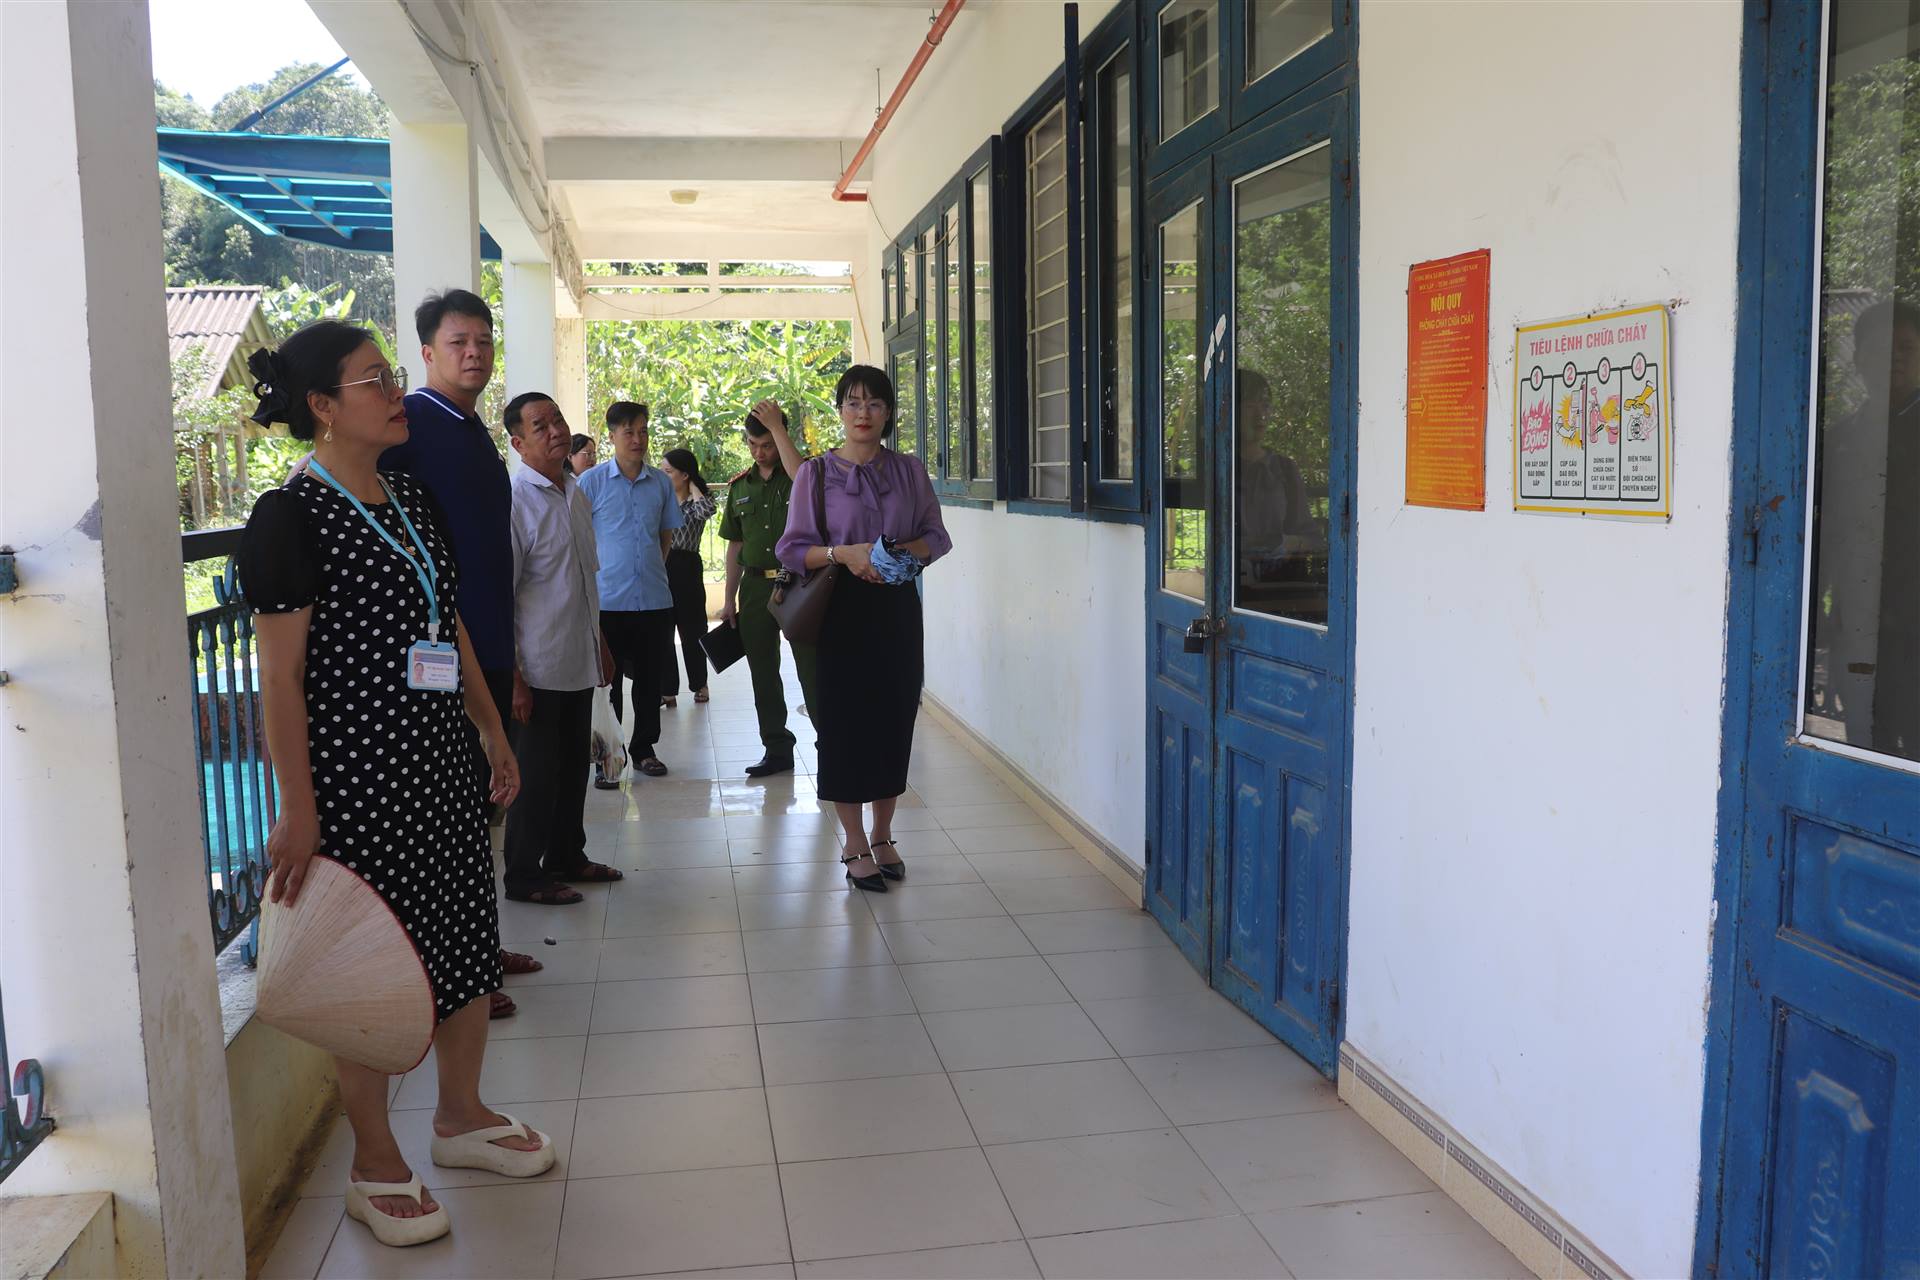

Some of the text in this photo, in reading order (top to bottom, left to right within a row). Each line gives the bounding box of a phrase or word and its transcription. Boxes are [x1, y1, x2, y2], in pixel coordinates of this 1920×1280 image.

[1431, 292, 1462, 314] NỘI QUY
[1530, 322, 1647, 356] TIÊU LỆNH CHỮA CHÁY
[1567, 367, 1573, 380] 2
[1602, 363, 1608, 378] 3
[1635, 359, 1643, 374] 4
[1534, 371, 1539, 384] 1
[1527, 415, 1543, 430] BÁO
[1524, 430, 1548, 453] ĐỘNG
